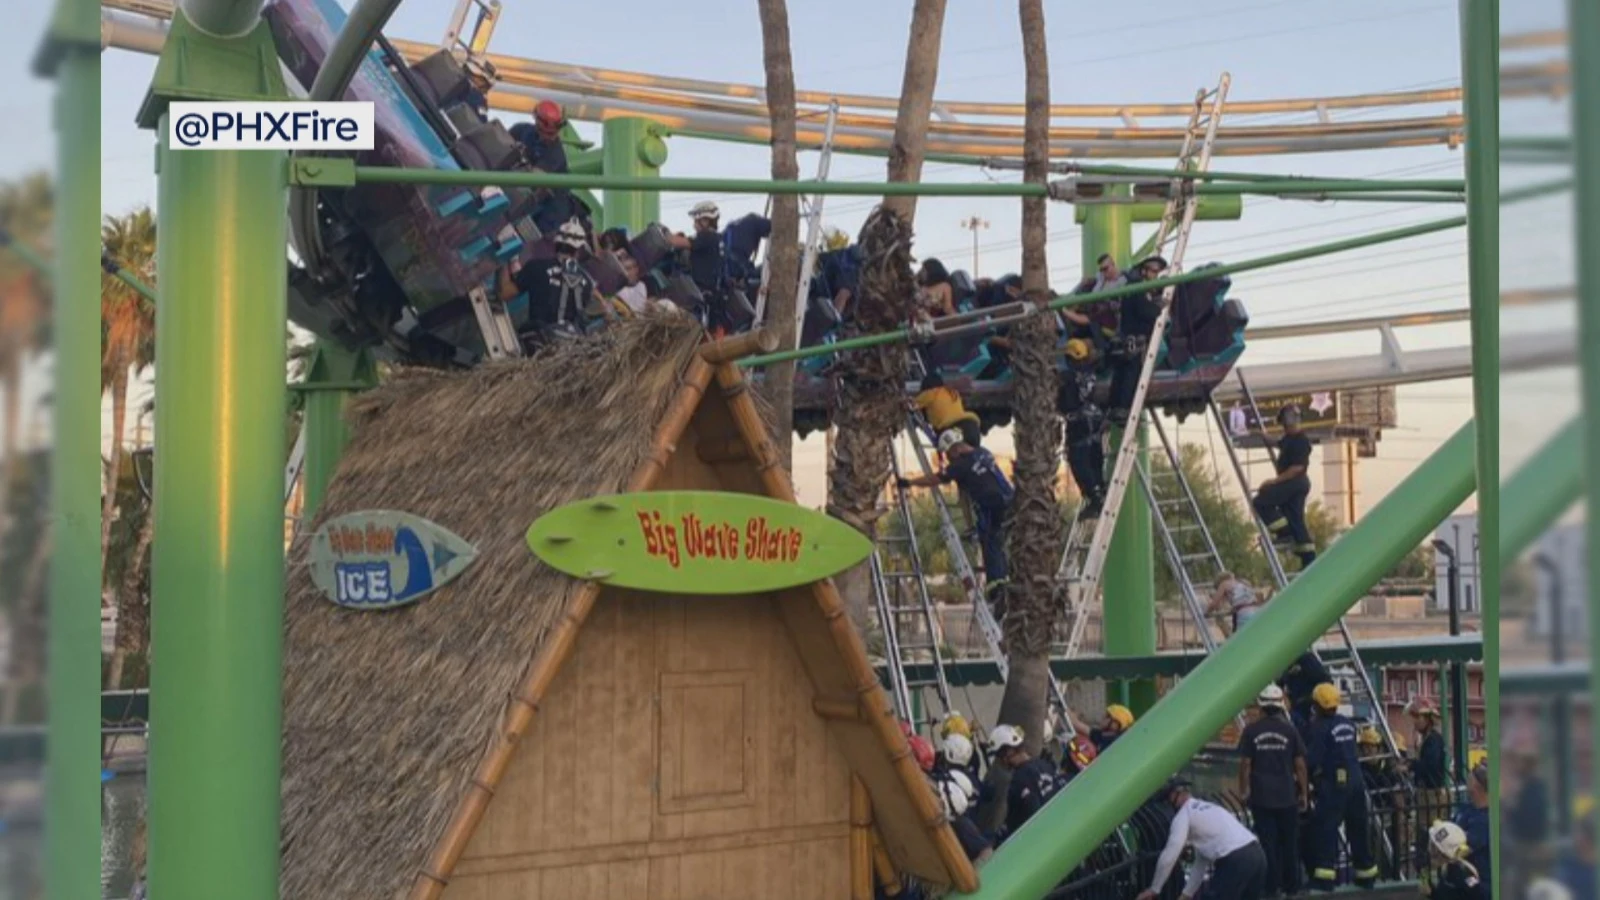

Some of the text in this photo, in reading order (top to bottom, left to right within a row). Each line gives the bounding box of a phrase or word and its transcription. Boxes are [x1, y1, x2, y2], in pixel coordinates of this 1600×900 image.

[637, 511, 803, 568] Big Wave Shave
[336, 567, 389, 602] ICE
